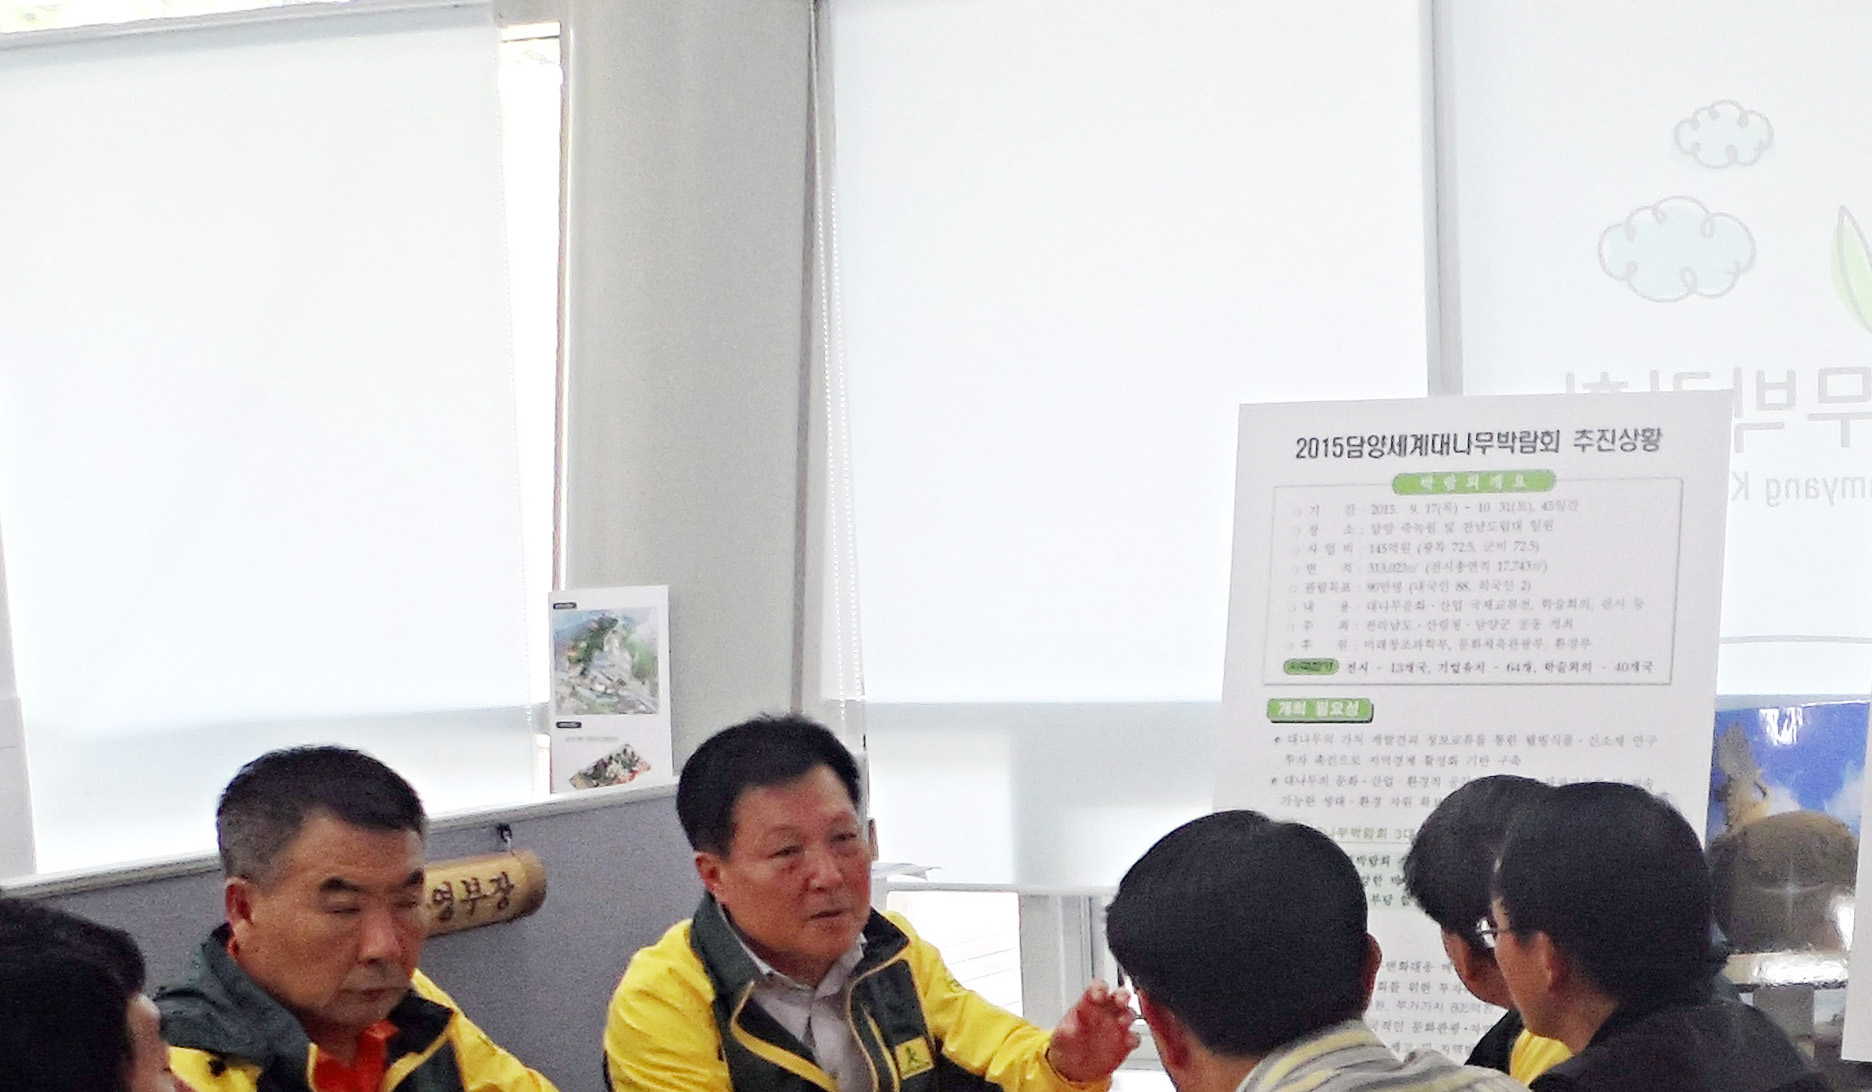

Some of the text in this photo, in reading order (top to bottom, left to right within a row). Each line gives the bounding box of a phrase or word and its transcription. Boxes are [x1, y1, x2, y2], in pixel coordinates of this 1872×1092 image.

[1295, 427, 1664, 460] 2015담양세계대나무박람회 추진상황
[431, 870, 515, 923] 영부장
